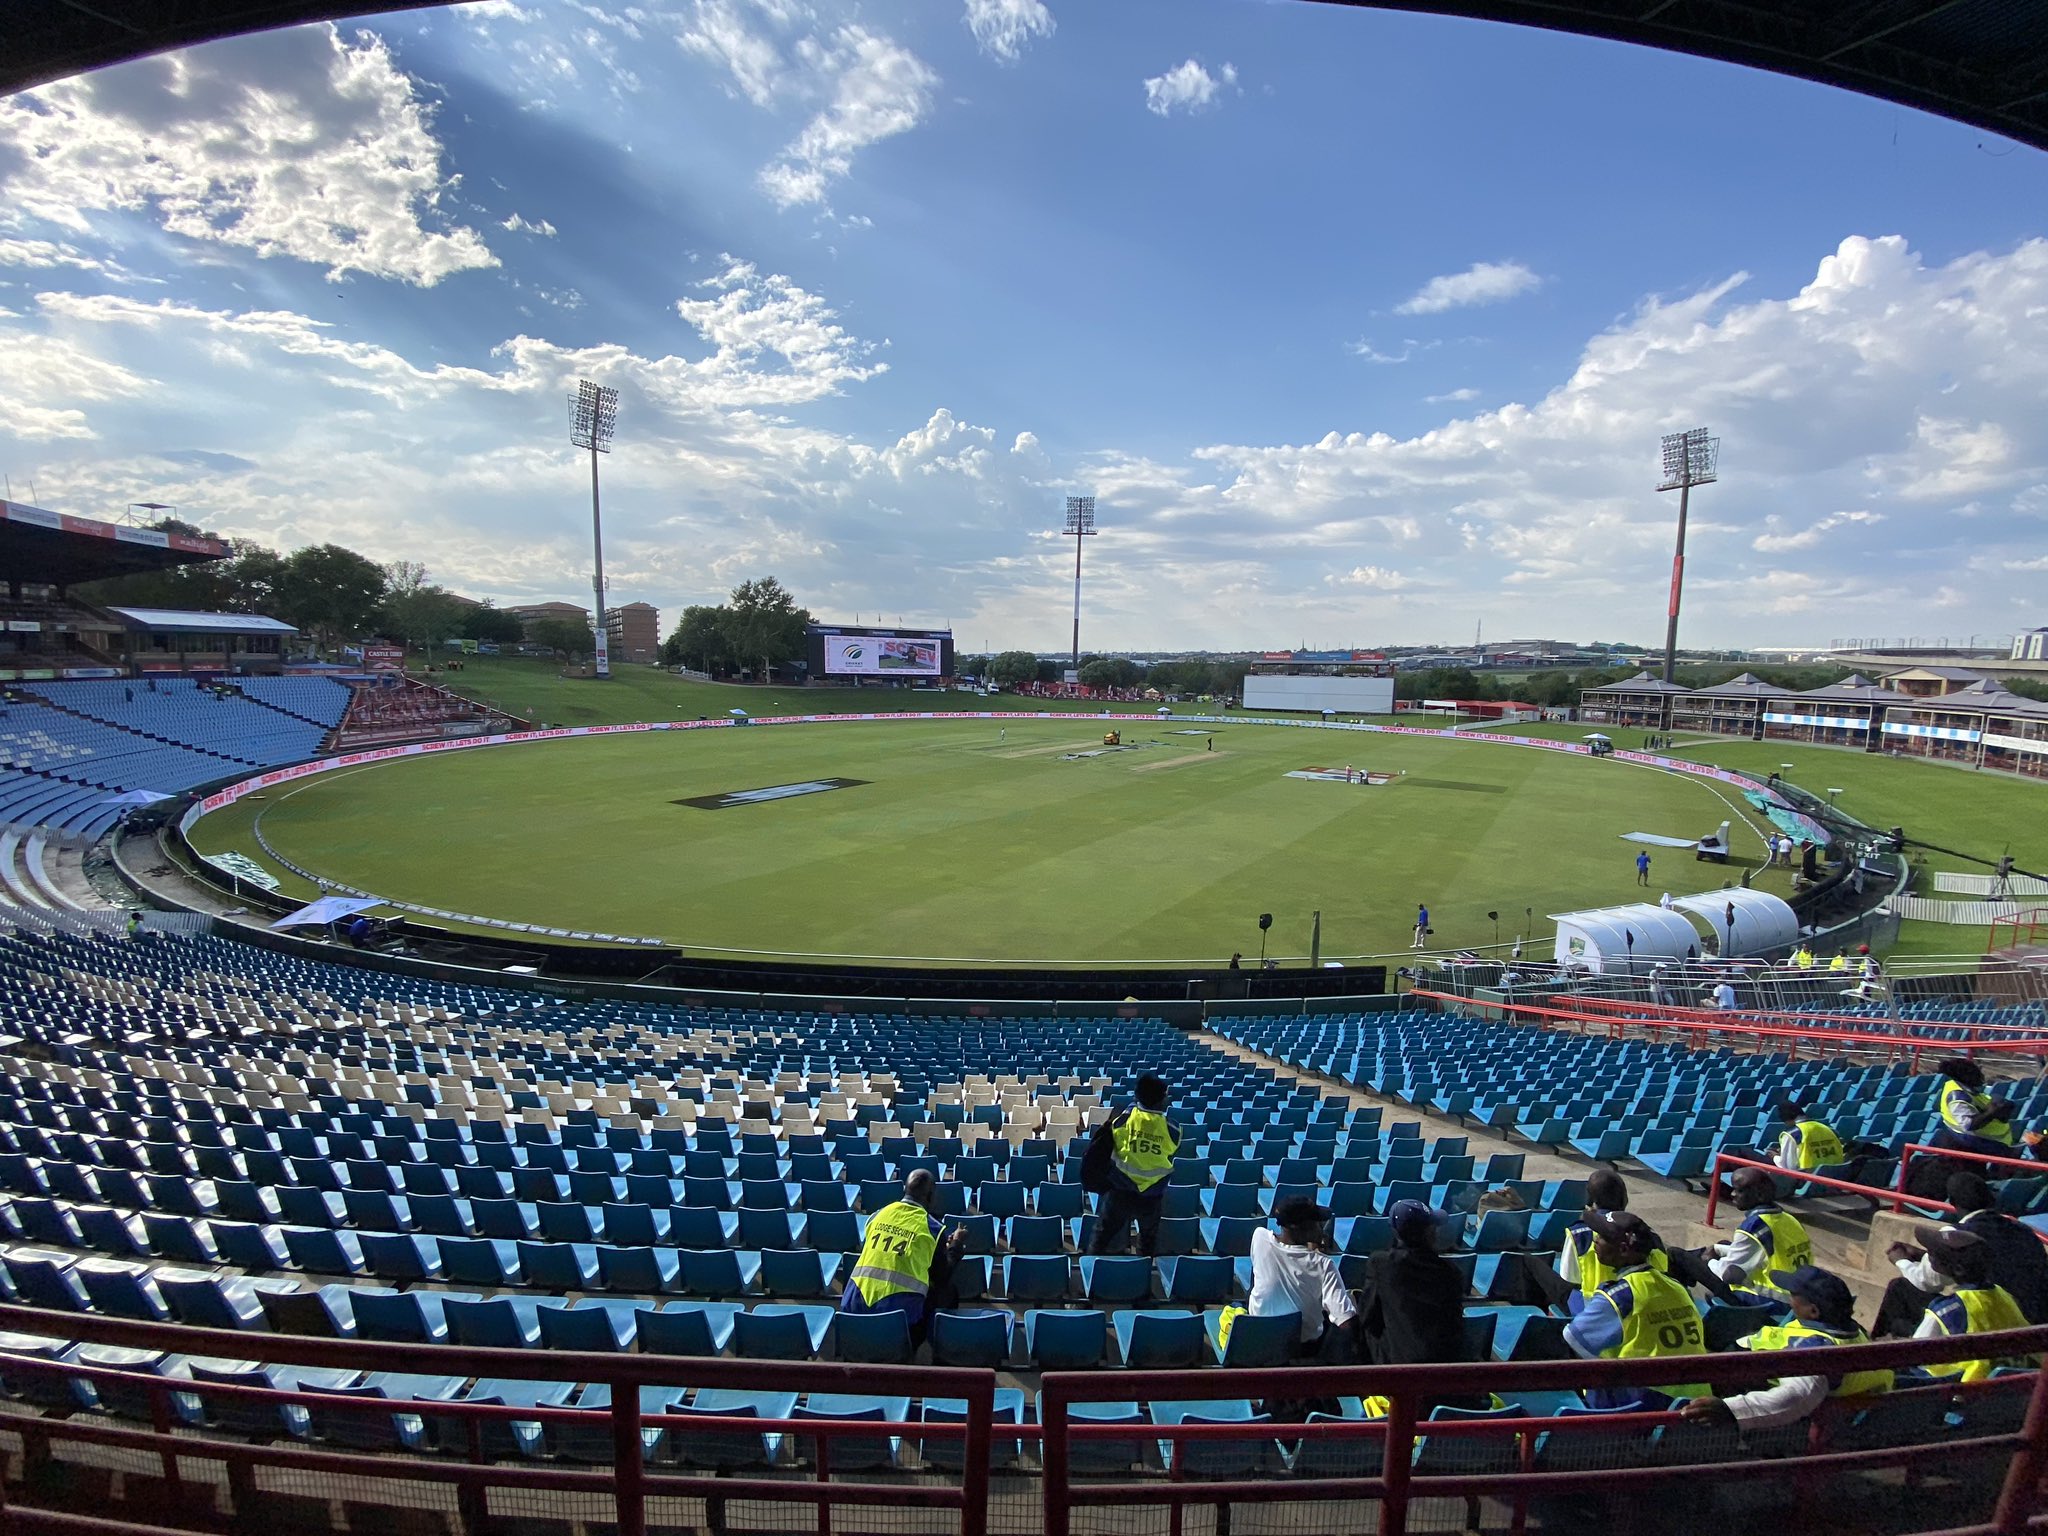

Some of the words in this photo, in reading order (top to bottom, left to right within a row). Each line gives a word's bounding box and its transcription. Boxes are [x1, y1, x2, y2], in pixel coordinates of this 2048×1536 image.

[505, 732, 529, 741] SCREW
[422, 742, 445, 751] SCREW
[1690, 765, 1705, 774] LETS
[204, 793, 224, 810] SCREW
[1856, 851, 1880, 859] EXIT
[1130, 1140, 1162, 1155] 155
[872, 1233, 908, 1256] 114
[1658, 1321, 1700, 1348] 05
